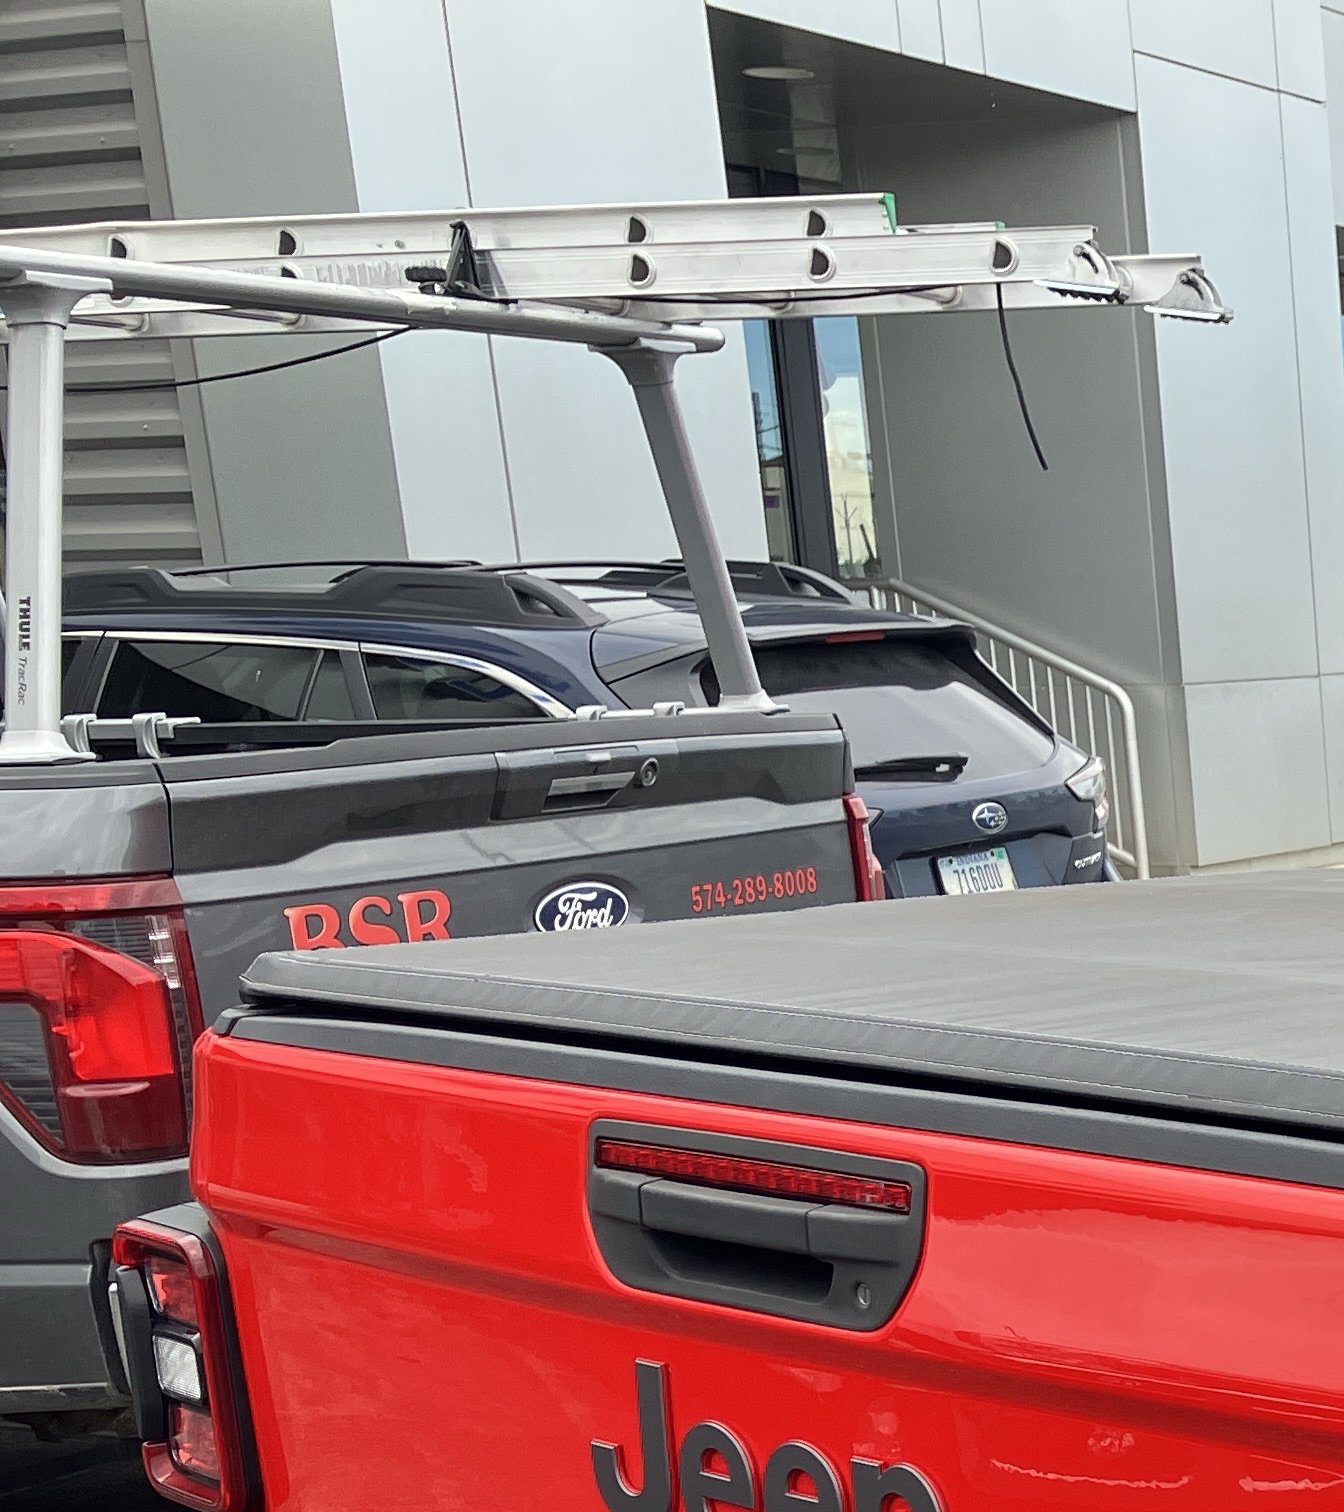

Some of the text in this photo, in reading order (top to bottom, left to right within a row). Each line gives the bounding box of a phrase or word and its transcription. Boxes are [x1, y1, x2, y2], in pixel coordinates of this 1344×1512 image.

[17, 596, 31, 706] THULE TracRac
[554, 891, 614, 932] Ford
[690, 866, 817, 913] 574-289-8008
